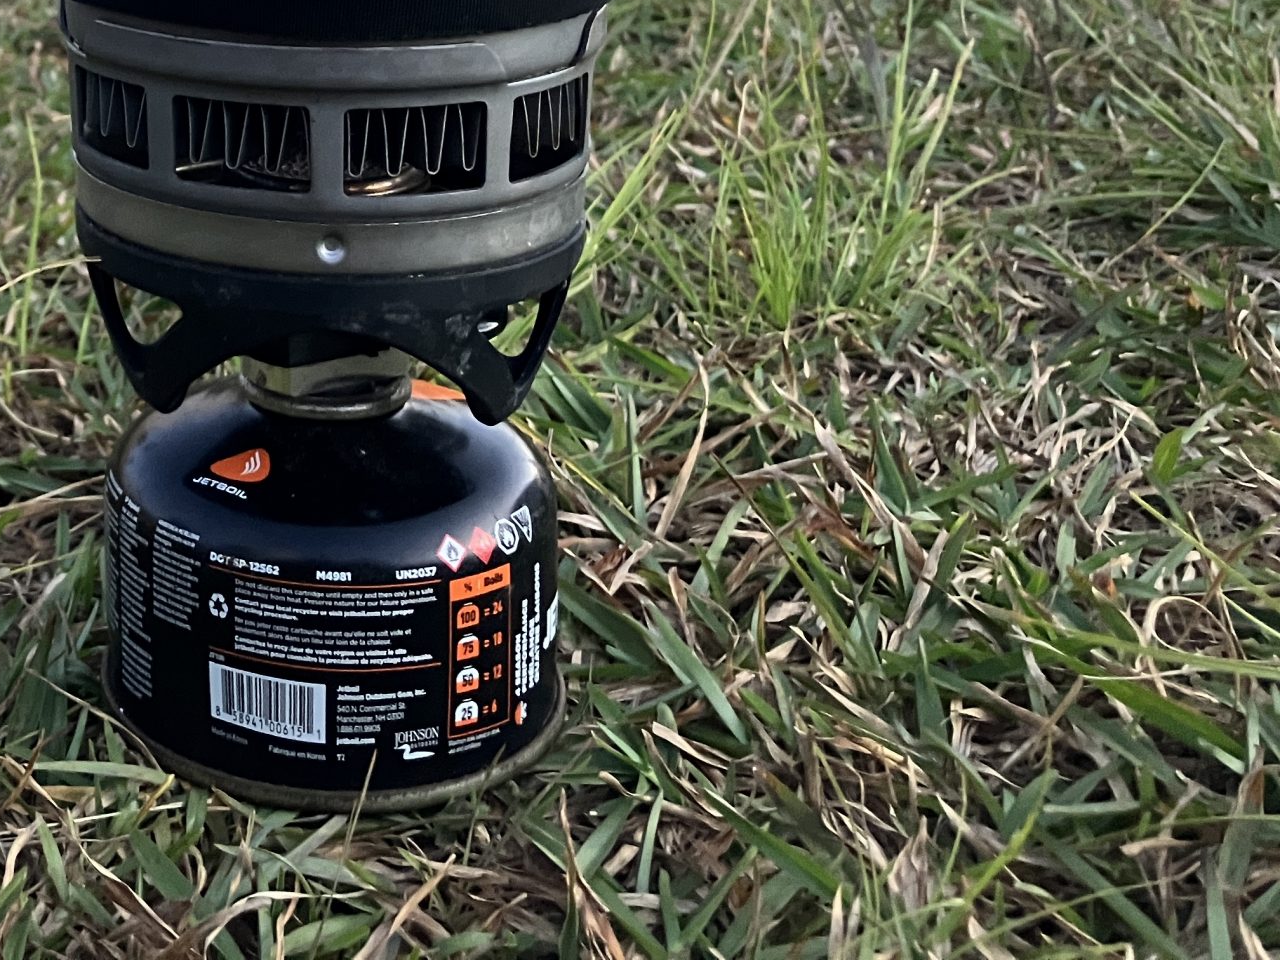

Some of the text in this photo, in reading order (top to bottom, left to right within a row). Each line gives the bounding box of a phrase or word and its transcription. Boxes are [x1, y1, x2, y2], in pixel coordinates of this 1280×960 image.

[192, 476, 248, 500] JETBOIL
[209, 551, 437, 582] DOT SP-12562 M4981 UN2037
[234, 578, 245, 587] Do
[245, 580, 257, 589] not
[257, 583, 281, 593] discard
[294, 589, 325, 598] cartridge
[325, 591, 341, 599] until
[341, 592, 363, 600] empty
[393, 590, 408, 598] only
[421, 587, 434, 595] safe
[463, 573, 504, 593] % Boils
[270, 593, 286, 601] from
[286, 595, 302, 603] heat.
[304, 597, 333, 606] Preserve
[380, 598, 400, 606] future
[234, 596, 260, 607] Contact
[275, 605, 292, 613] local
[343, 610, 381, 618] jetboil.com
[392, 609, 415, 617] proper
[234, 604, 263, 616] recycling
[460, 611, 476, 623] 100
[290, 626, 323, 636] cartouche
[389, 628, 404, 636] vide
[349, 638, 359, 646] de
[461, 642, 475, 655] 75
[461, 674, 474, 687] 50
[493, 663, 503, 679] 12
[336, 685, 360, 693] Jetboil
[336, 693, 365, 701] Johnson
[365, 693, 397, 701] Outdoors
[336, 704, 351, 713] 540
[359, 702, 398, 713] Commercial
[461, 707, 473, 721] 25
[491, 699, 498, 713] 6
[215, 705, 221, 716] 8
[233, 711, 264, 730] 58941
[269, 721, 303, 737] 00615
[336, 715, 374, 723] Manchester,
[336, 737, 376, 746] jetboil.com
[393, 726, 440, 750] JOHNSON
